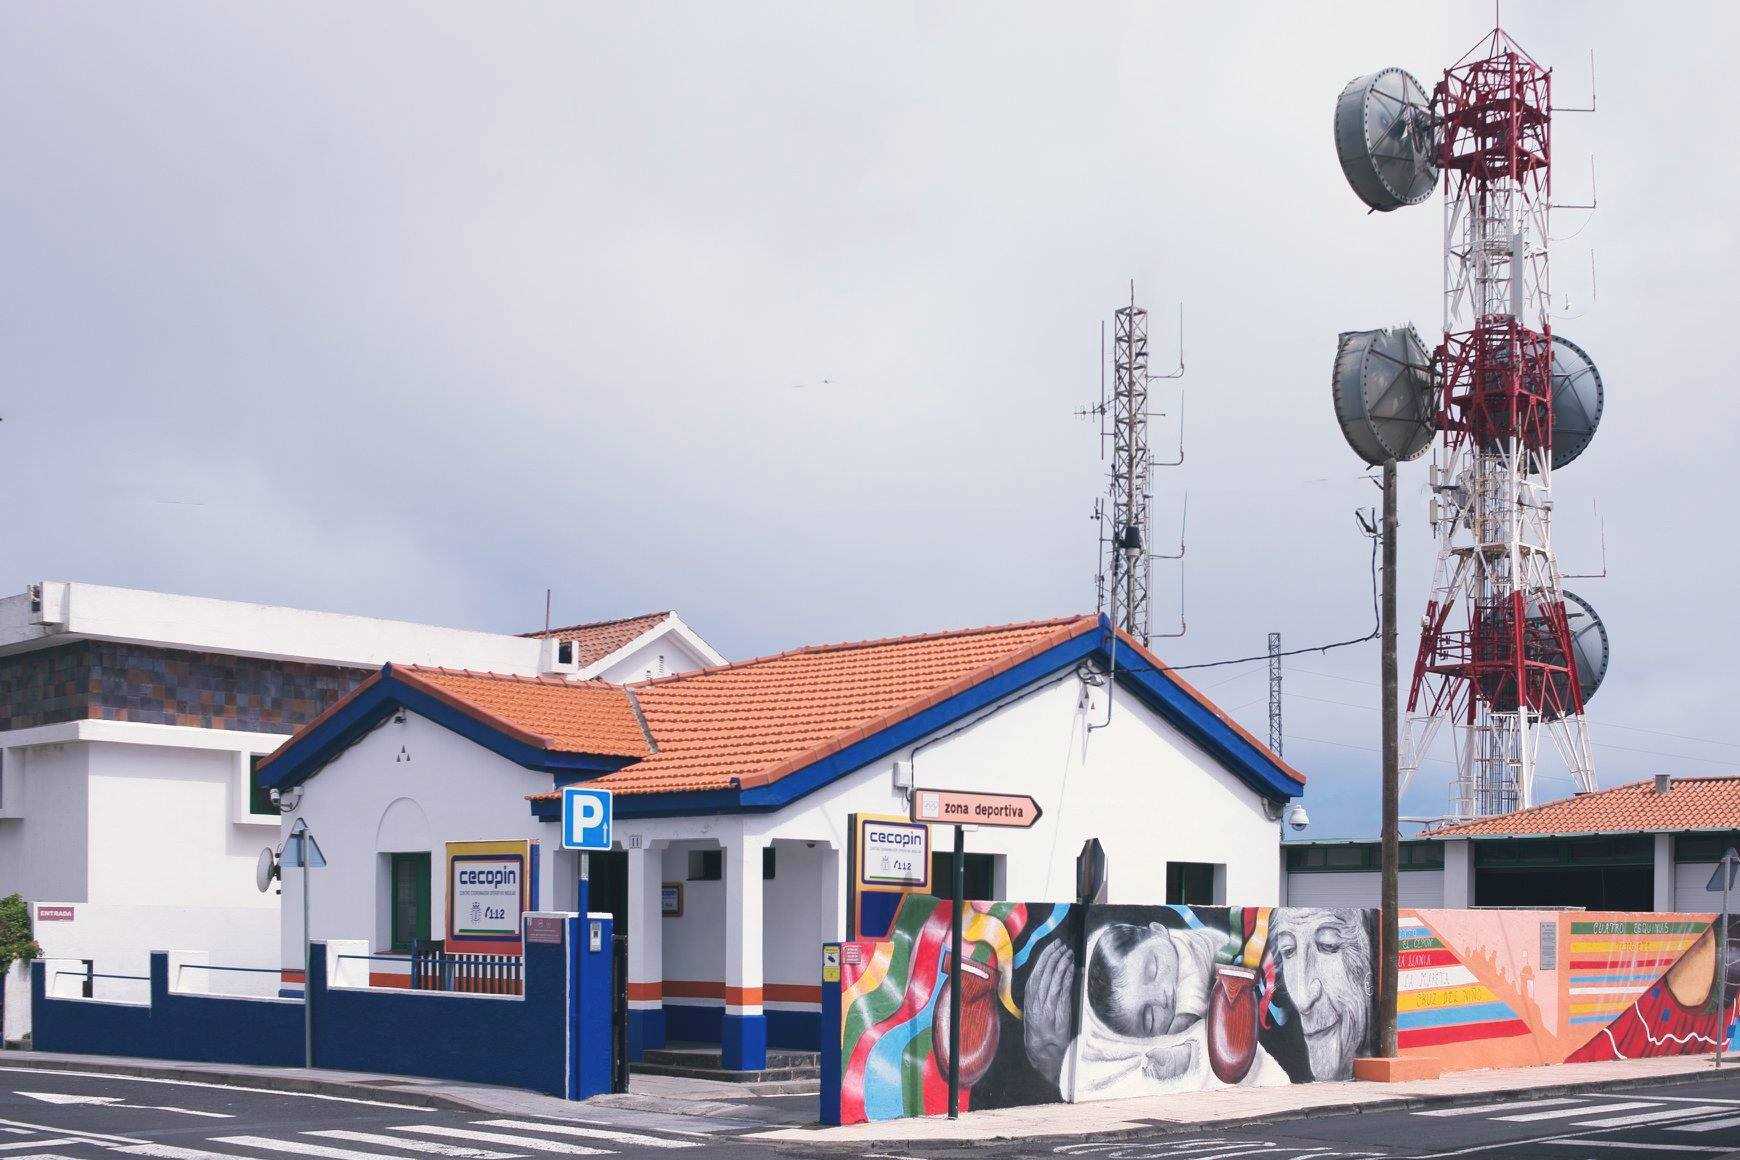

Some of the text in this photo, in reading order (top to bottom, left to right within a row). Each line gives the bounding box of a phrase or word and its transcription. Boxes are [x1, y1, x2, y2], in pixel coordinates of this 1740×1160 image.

[572, 794, 604, 843] P
[945, 802, 1024, 819] zona deportiva
[870, 832, 922, 847] cecopin
[459, 865, 517, 889] cecopin
[1592, 922, 1625, 934] CUATRO
[1416, 992, 1437, 1007] CRUZ
